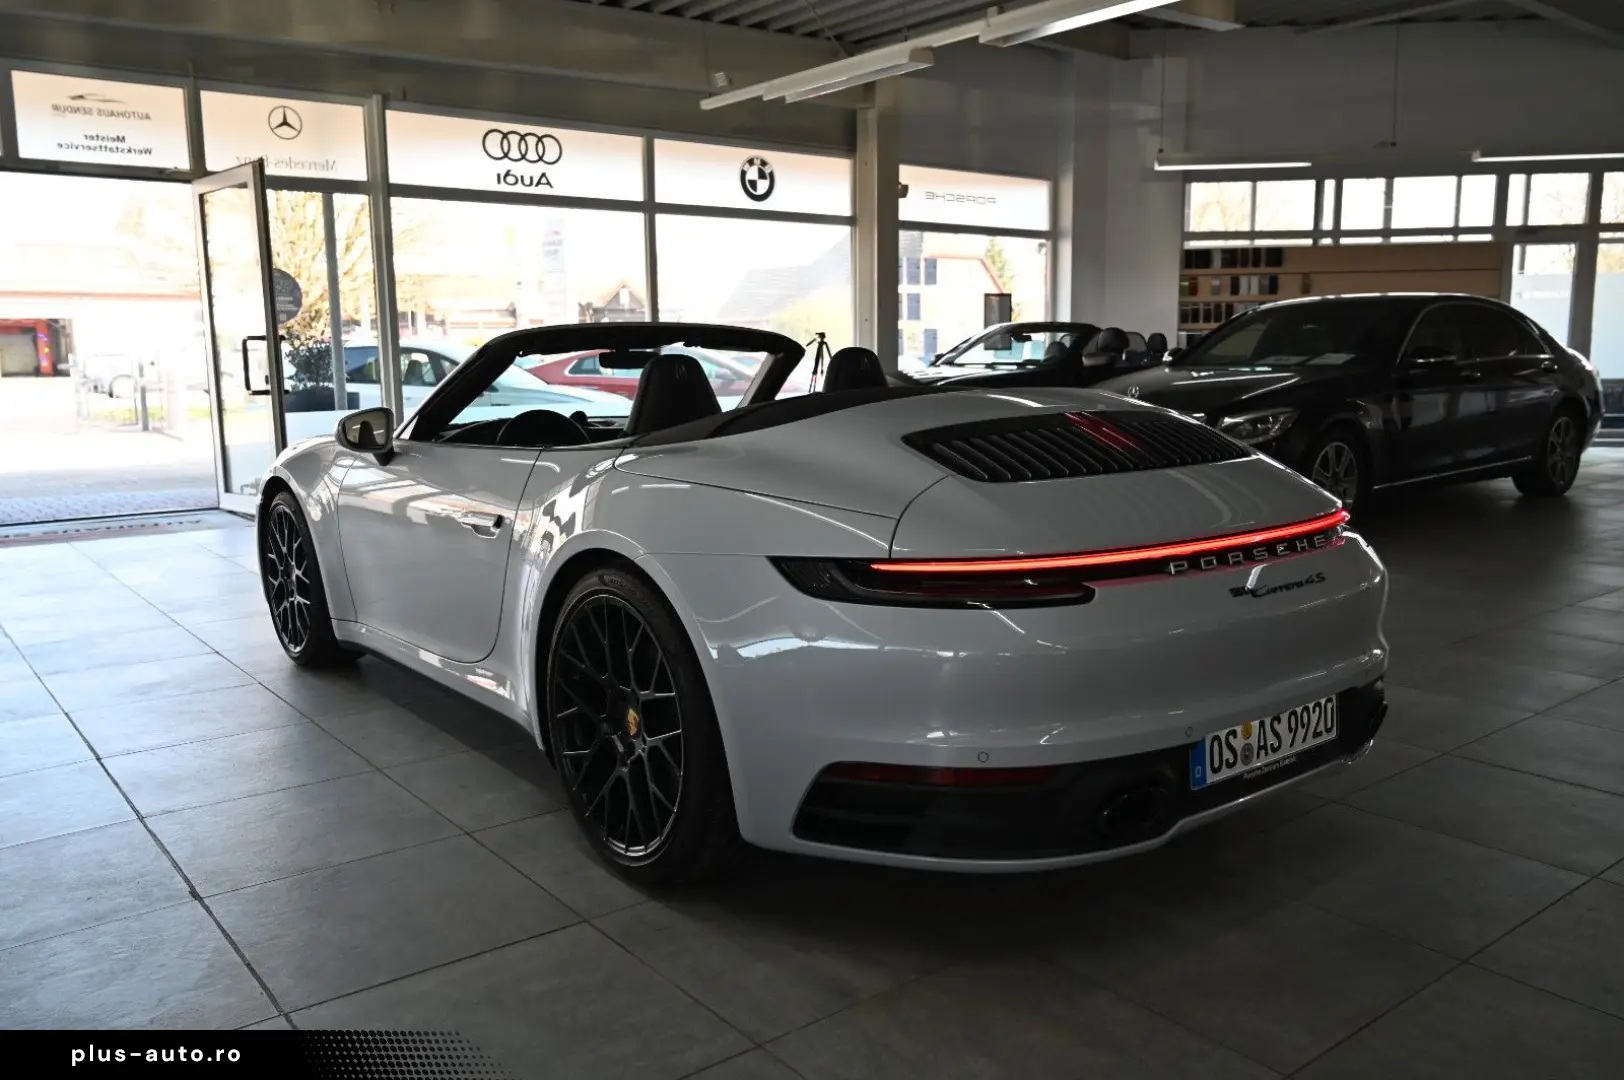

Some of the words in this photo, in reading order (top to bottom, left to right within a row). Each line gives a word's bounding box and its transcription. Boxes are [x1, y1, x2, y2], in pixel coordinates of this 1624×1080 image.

[1169, 535, 1326, 575] PORSCHE
[1195, 766, 1202, 777] D
[1210, 729, 1237, 773] OS
[1257, 716, 1282, 759] AS
[1288, 697, 1334, 747] 9920
